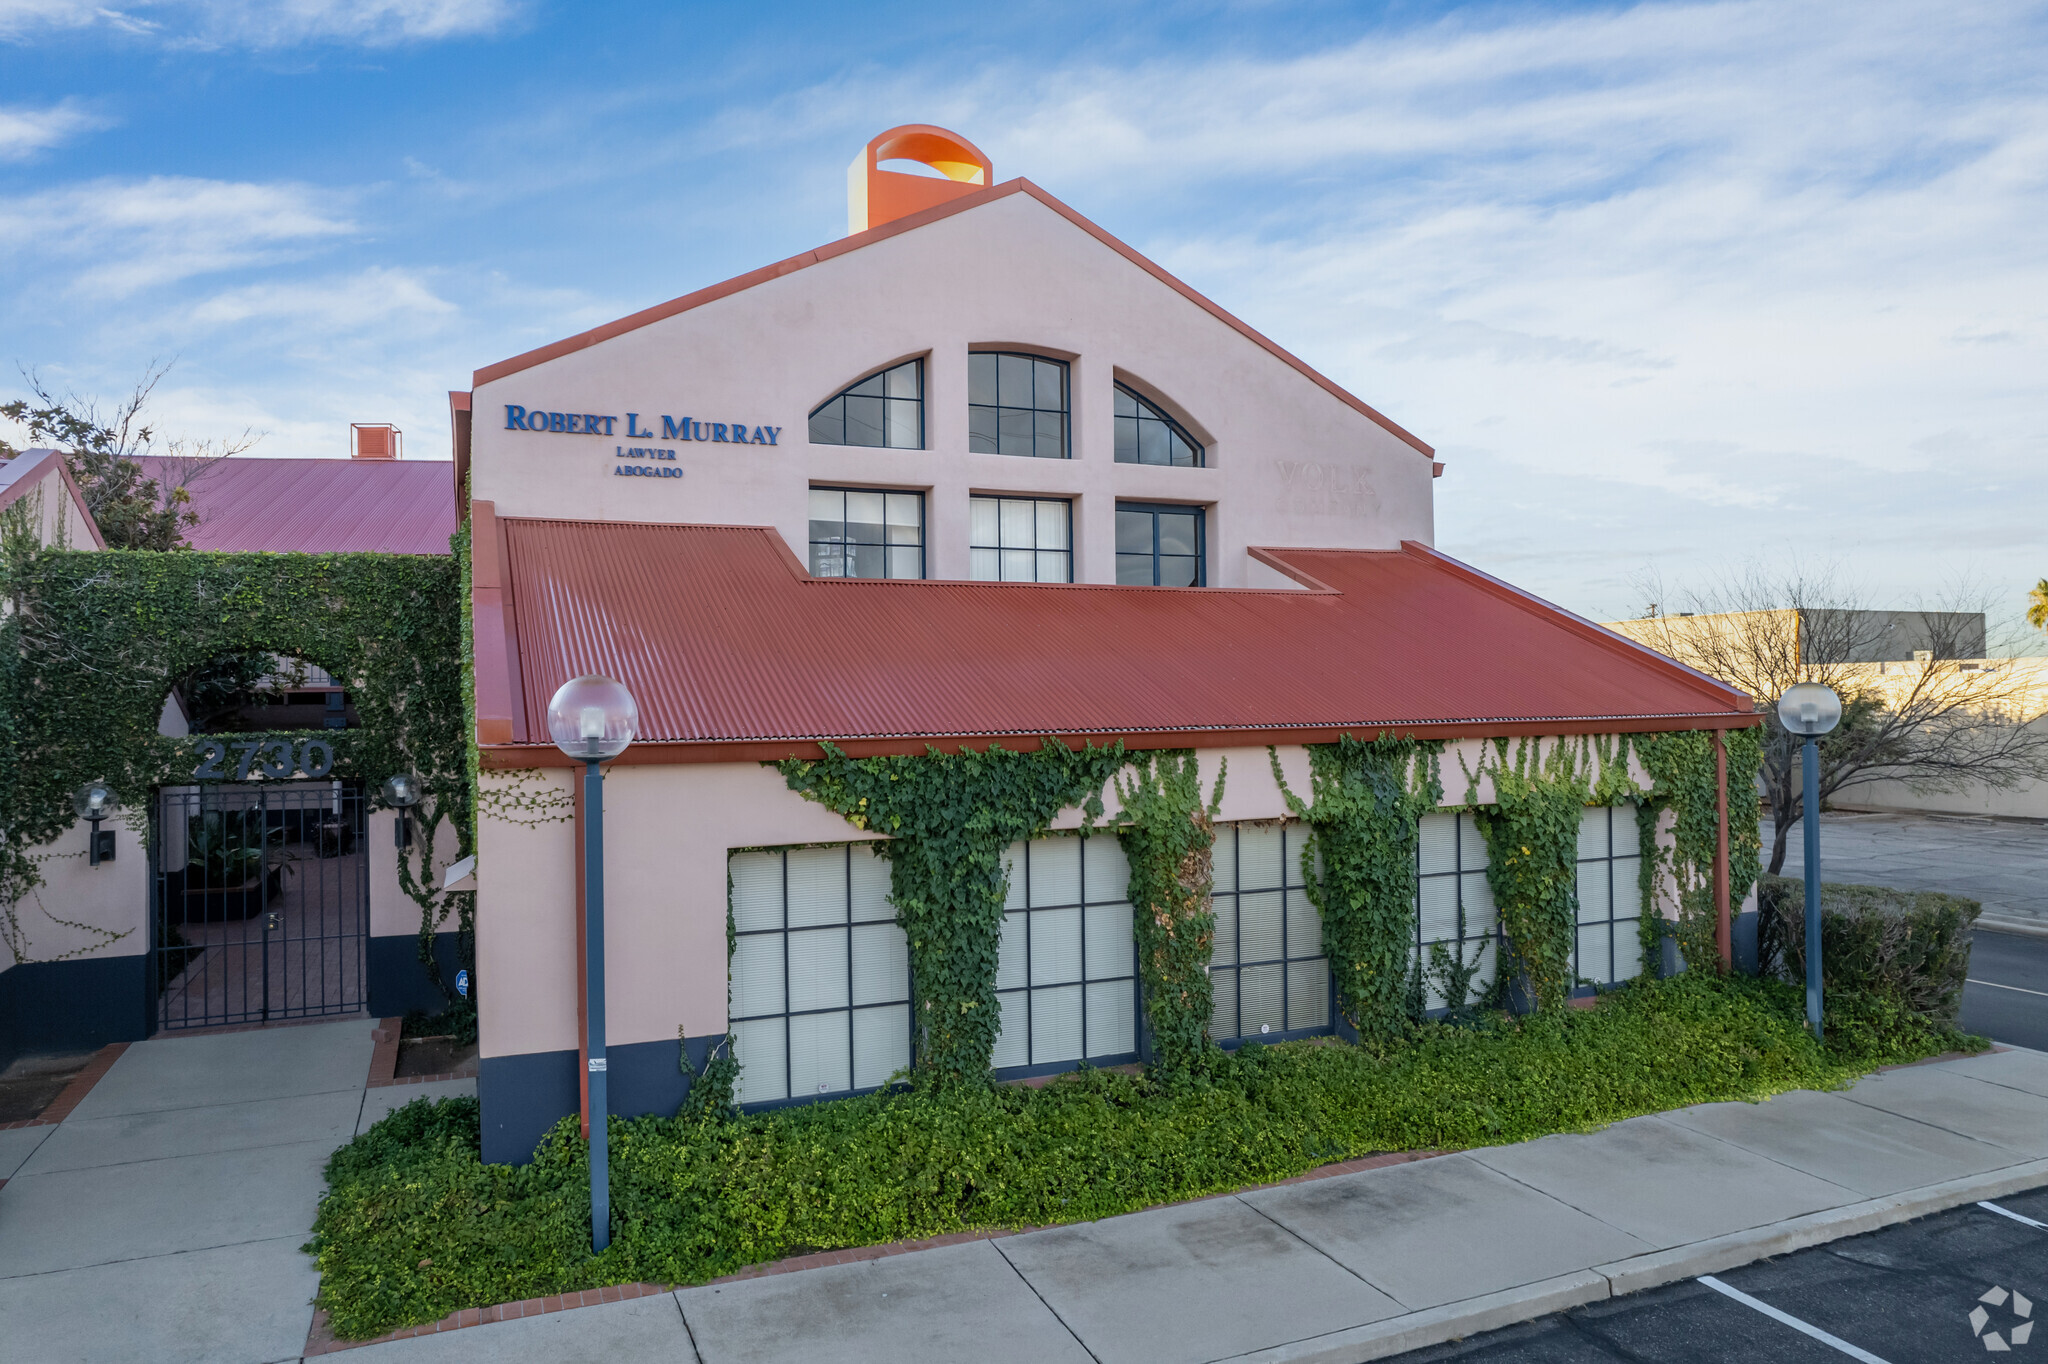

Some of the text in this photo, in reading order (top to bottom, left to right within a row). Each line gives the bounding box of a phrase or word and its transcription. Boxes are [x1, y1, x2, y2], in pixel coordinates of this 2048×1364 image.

[504, 404, 782, 446] ROBERT L. MURRAY
[616, 446, 676, 460] LAWYER
[614, 465, 683, 478] ABOGADO
[194, 739, 333, 779] 2730
